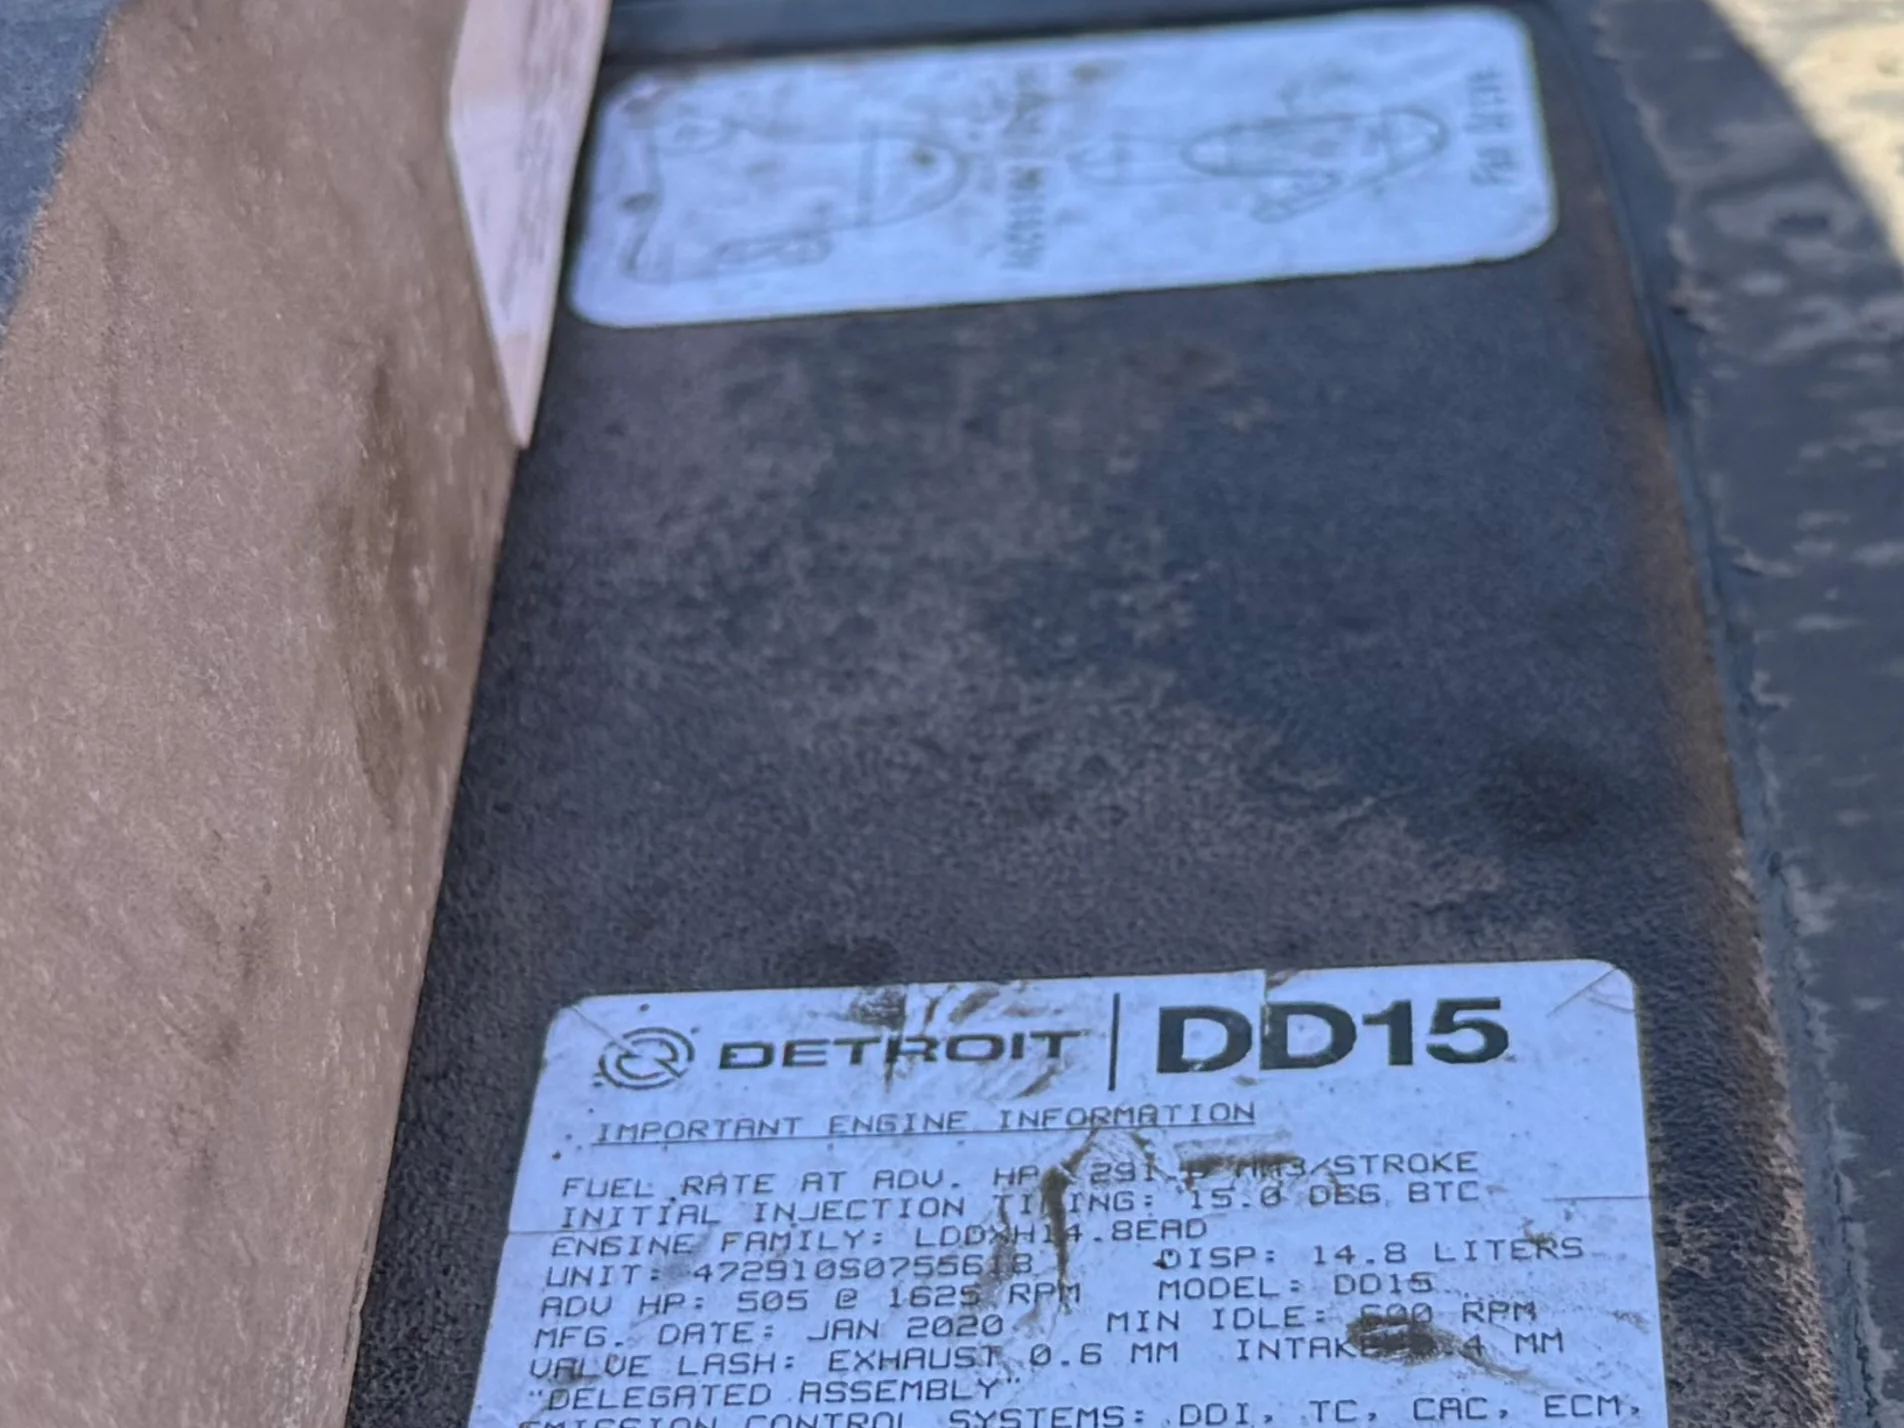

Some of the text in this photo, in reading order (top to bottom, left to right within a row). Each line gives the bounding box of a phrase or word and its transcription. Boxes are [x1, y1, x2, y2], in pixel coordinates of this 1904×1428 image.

[717, 1029, 1084, 1071] DETROIT
[1155, 995, 1509, 1074] DD15
[596, 1101, 1256, 1141] IMPORTANT ENGINE INFORMATION
[560, 1175, 656, 1198] FUEL
[679, 1172, 775, 1195] RATE
[798, 1170, 847, 1191] AT
[871, 1166, 959, 1189] ADV.
[558, 1202, 724, 1228] INITIAL
[750, 1195, 965, 1222] INJECTION
[1189, 1186, 1283, 1210] 15.0
[1309, 1183, 1382, 1206] DEG
[1408, 1180, 1482, 1203] BTC
[549, 1232, 695, 1257] ENGINE
[718, 1227, 882, 1252] FAMILY:
[1159, 1237, 1586, 1270] DISP: 14.8 LITERS
[544, 1263, 660, 1287] UNIT:
[1157, 1272, 1434, 1300] MODEL: DD15
[538, 1281, 1082, 1317] ADV HP: 505 @ 1625 RPM
[1105, 1309, 1180, 1332] MIN
[1210, 1305, 1325, 1330] IDLE:
[1462, 1300, 1538, 1323] RPM
[532, 1314, 1004, 1348] MFG. DATE: JAN 2020
[1515, 1331, 1566, 1354] MM
[527, 1341, 1180, 1379] VALVE LASH: EXHAUST 0.6 MM
[1178, 1402, 1274, 1427] DDI,
[1310, 1400, 1378, 1424] TC,
[1413, 1397, 1510, 1421] CAC,
[1544, 1393, 1642, 1418] ECM,
